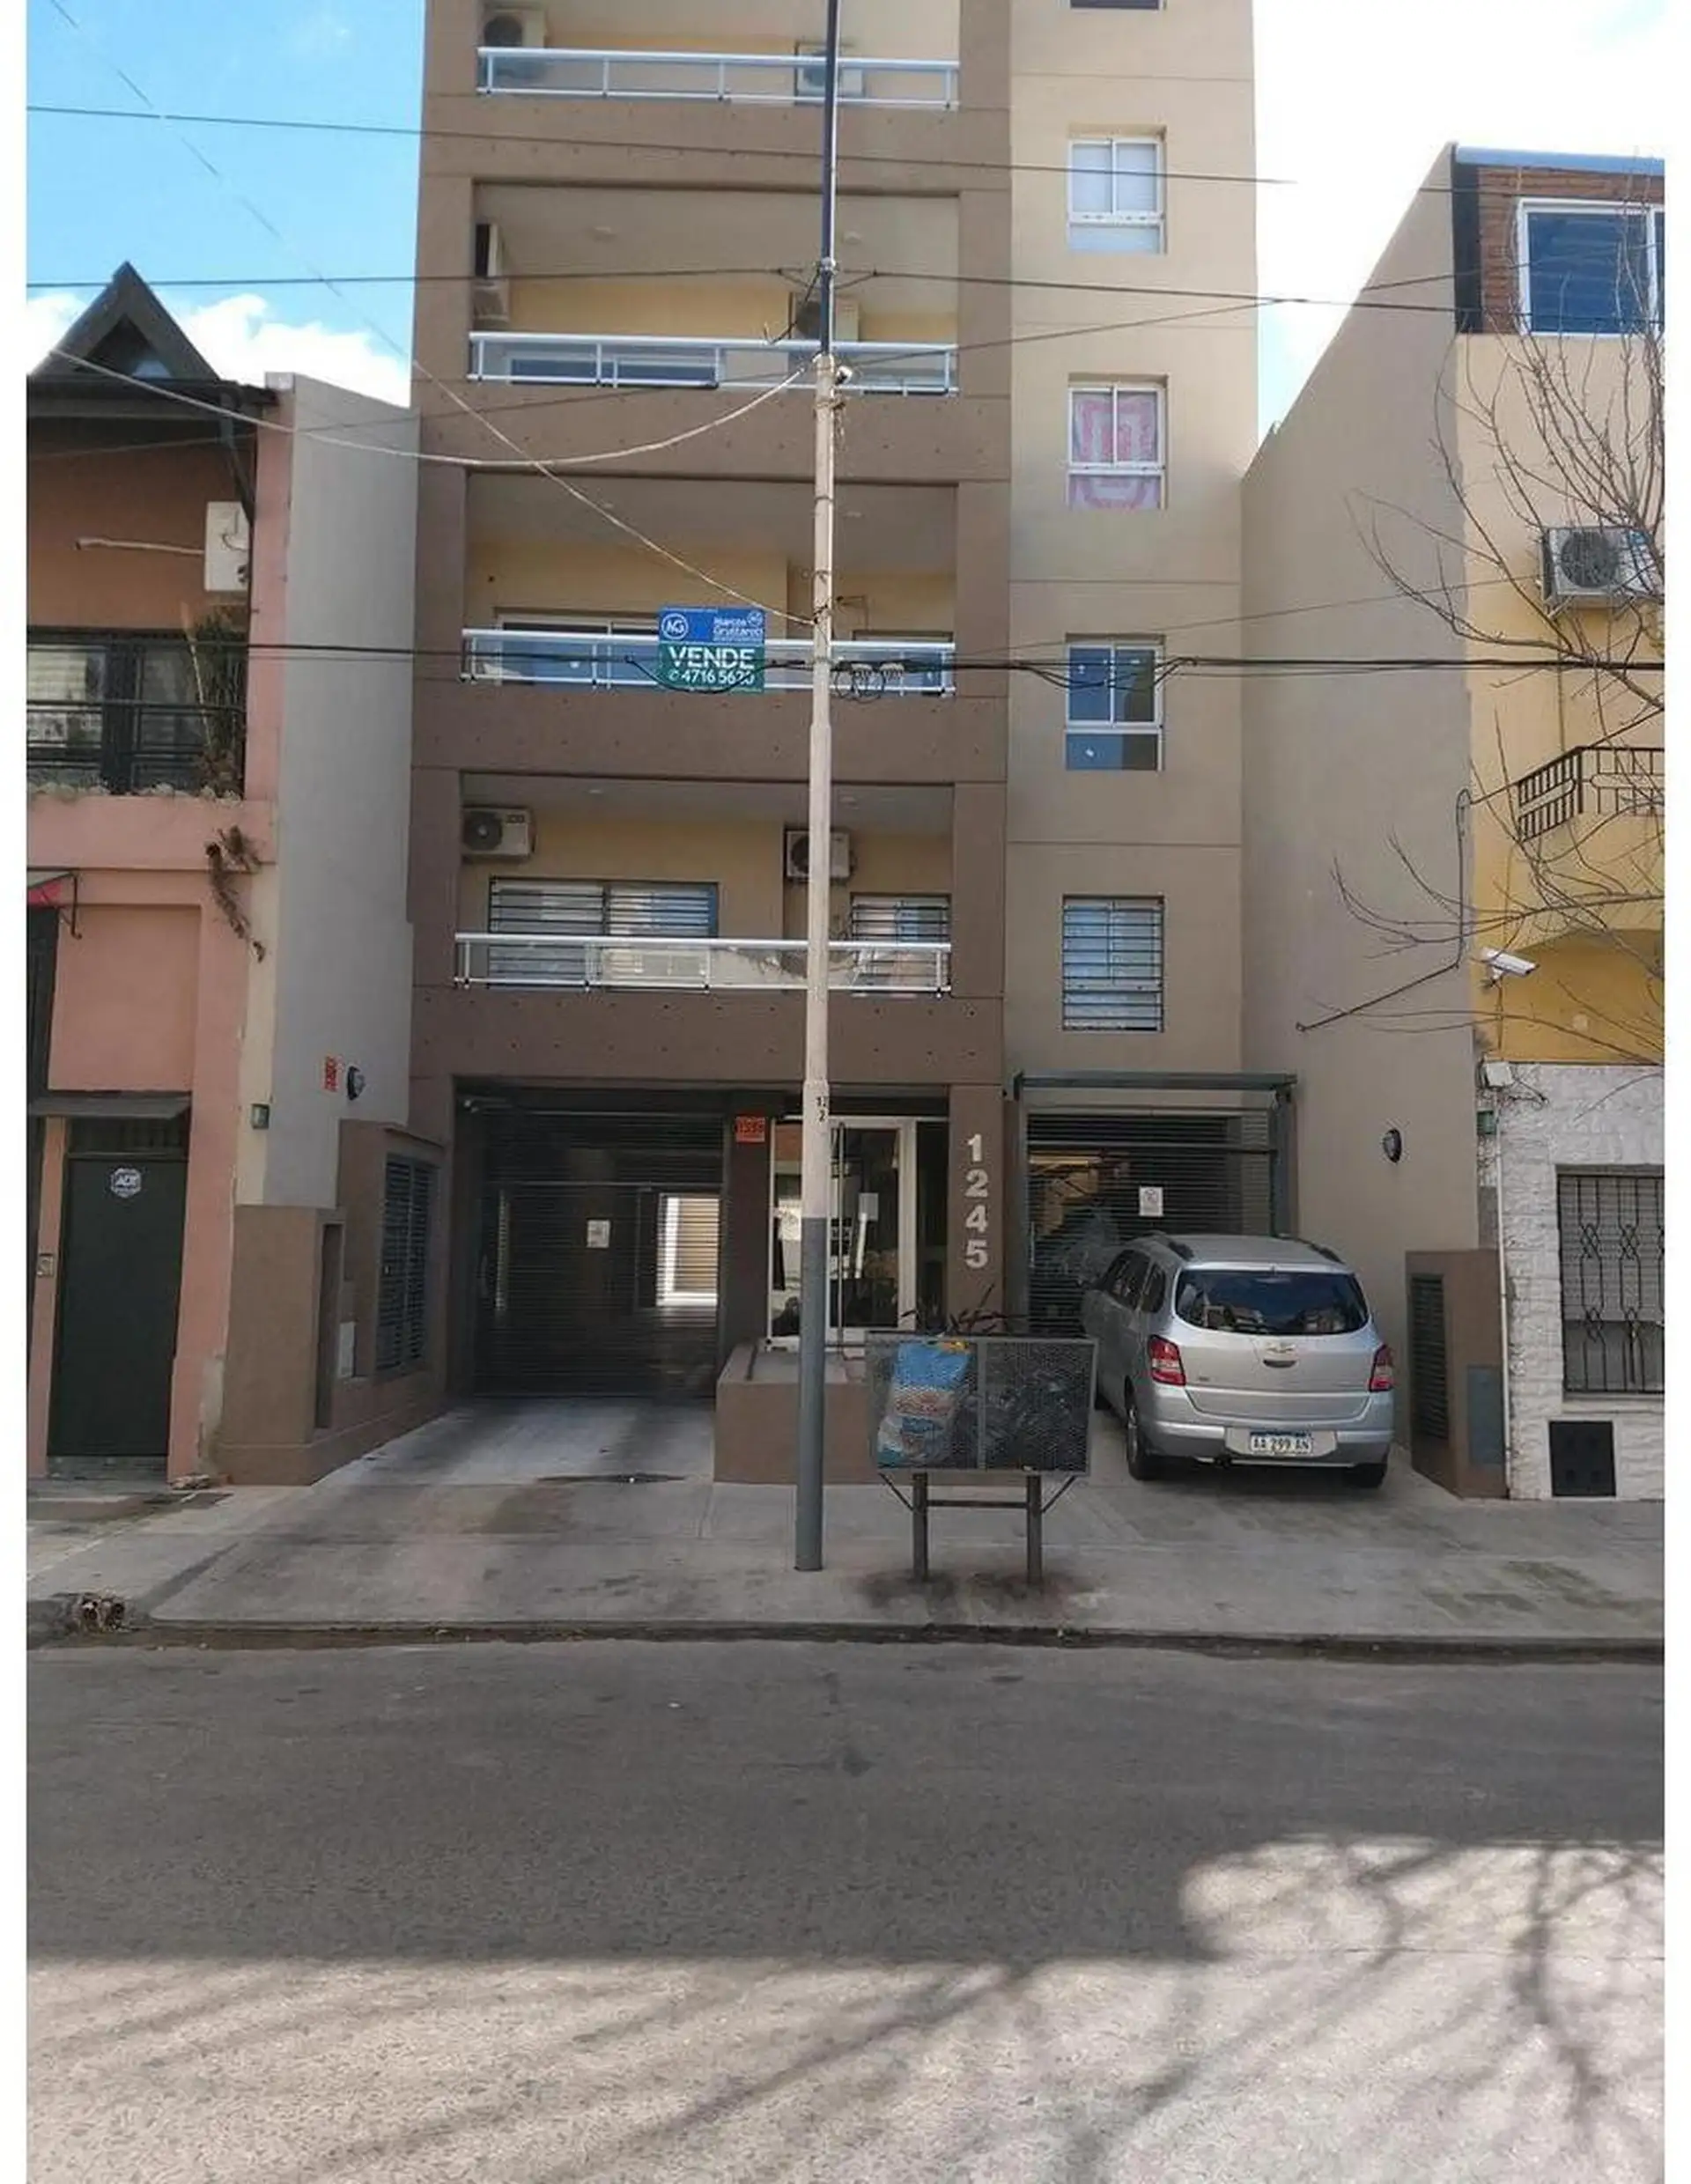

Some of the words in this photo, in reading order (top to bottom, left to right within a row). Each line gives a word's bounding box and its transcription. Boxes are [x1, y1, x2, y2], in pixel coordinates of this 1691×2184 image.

[669, 646, 756, 669] VENDE
[682, 669, 716, 683] 4716
[965, 1133, 988, 1268] 1245
